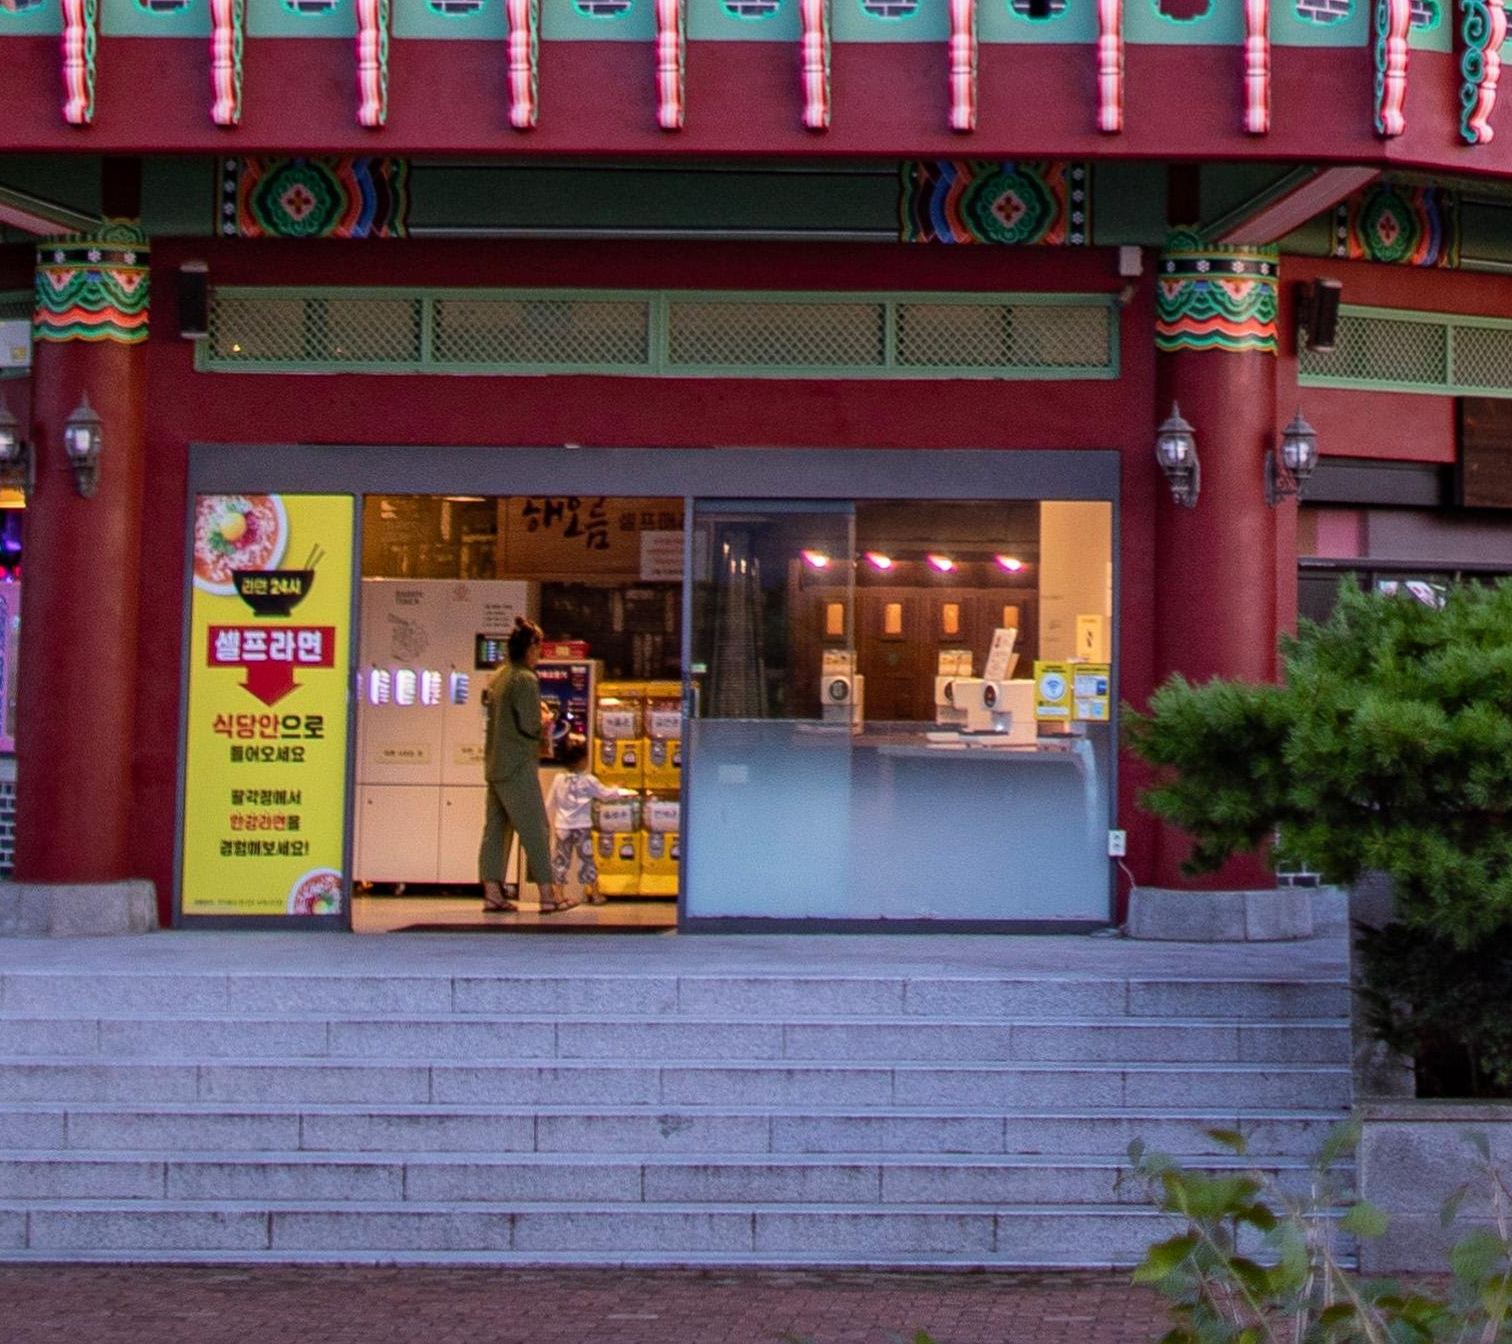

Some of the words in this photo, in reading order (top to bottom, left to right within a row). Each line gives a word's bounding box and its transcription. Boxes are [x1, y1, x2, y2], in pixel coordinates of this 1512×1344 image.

[215, 629, 323, 662] 셀프라면
[212, 713, 325, 740] 식당안으로
[230, 745, 306, 763] 들어오세요
[231, 789, 302, 806] 팔각정에서
[220, 839, 310, 857] 경험해보세요!
